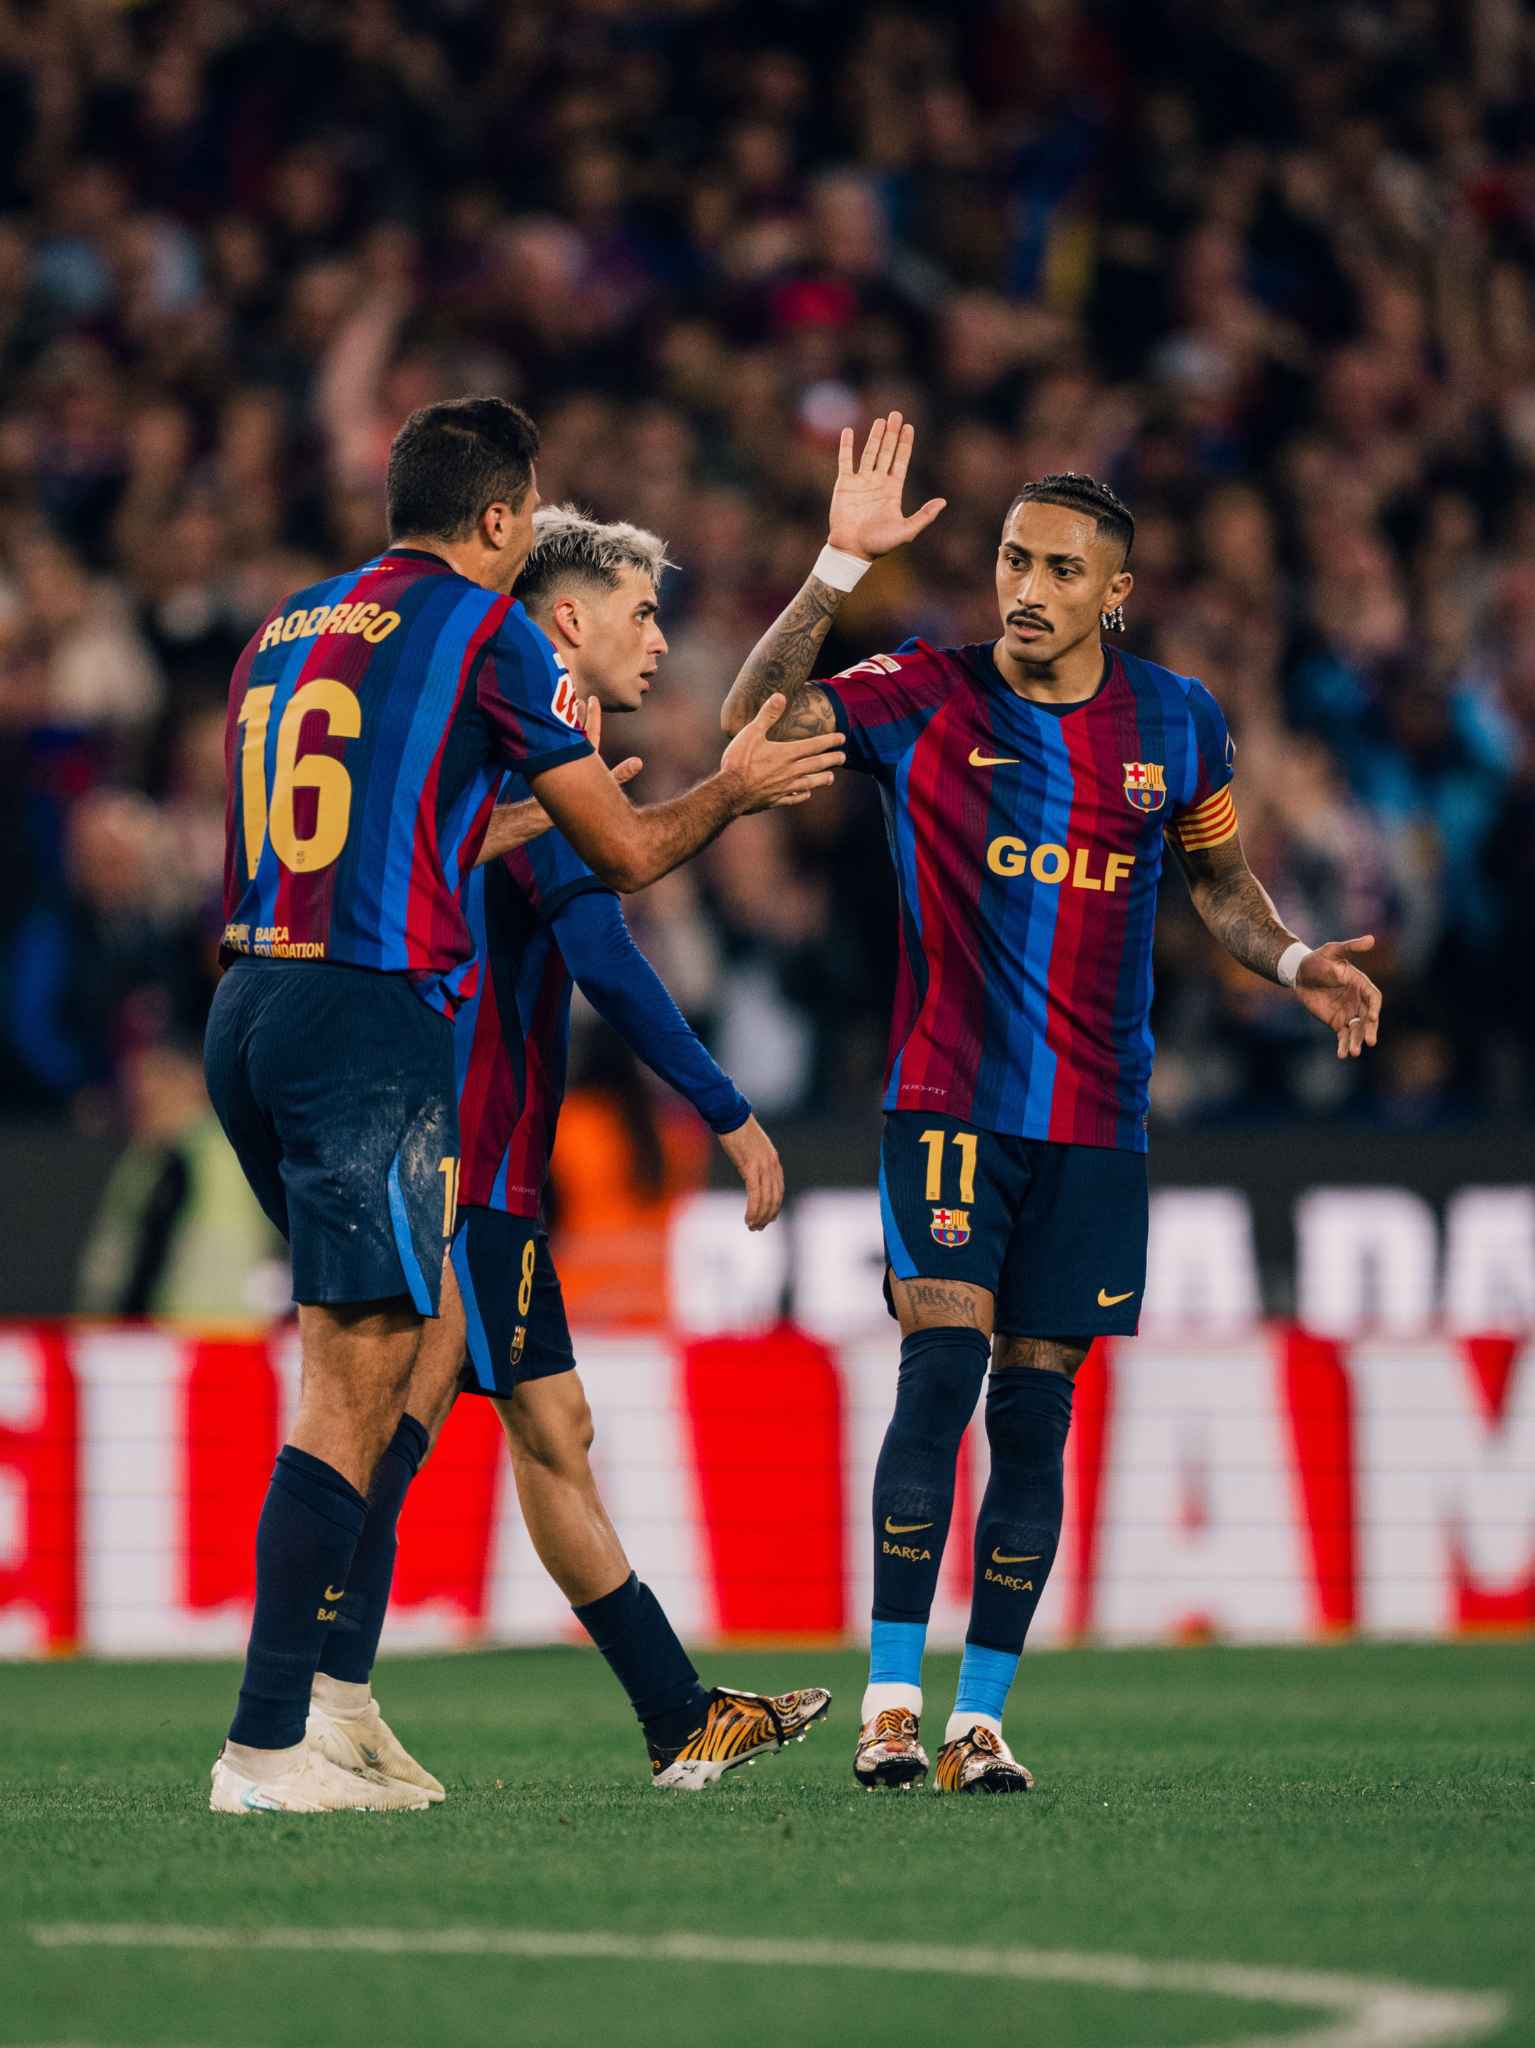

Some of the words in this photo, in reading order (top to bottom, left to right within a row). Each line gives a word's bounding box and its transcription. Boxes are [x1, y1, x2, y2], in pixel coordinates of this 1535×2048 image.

[259, 602, 401, 652] RODRIGO
[236, 678, 362, 881] 16
[986, 835, 1136, 893] GOLF
[253, 942, 325, 959] FOUNDATION
[255, 927, 289, 944] BARÇA
[918, 1129, 979, 1205] 11
[437, 1156, 461, 1238] 1
[517, 1238, 536, 1317] 8
[882, 1541, 931, 1561] BARÇA
[984, 1569, 1033, 1590] BARÇA
